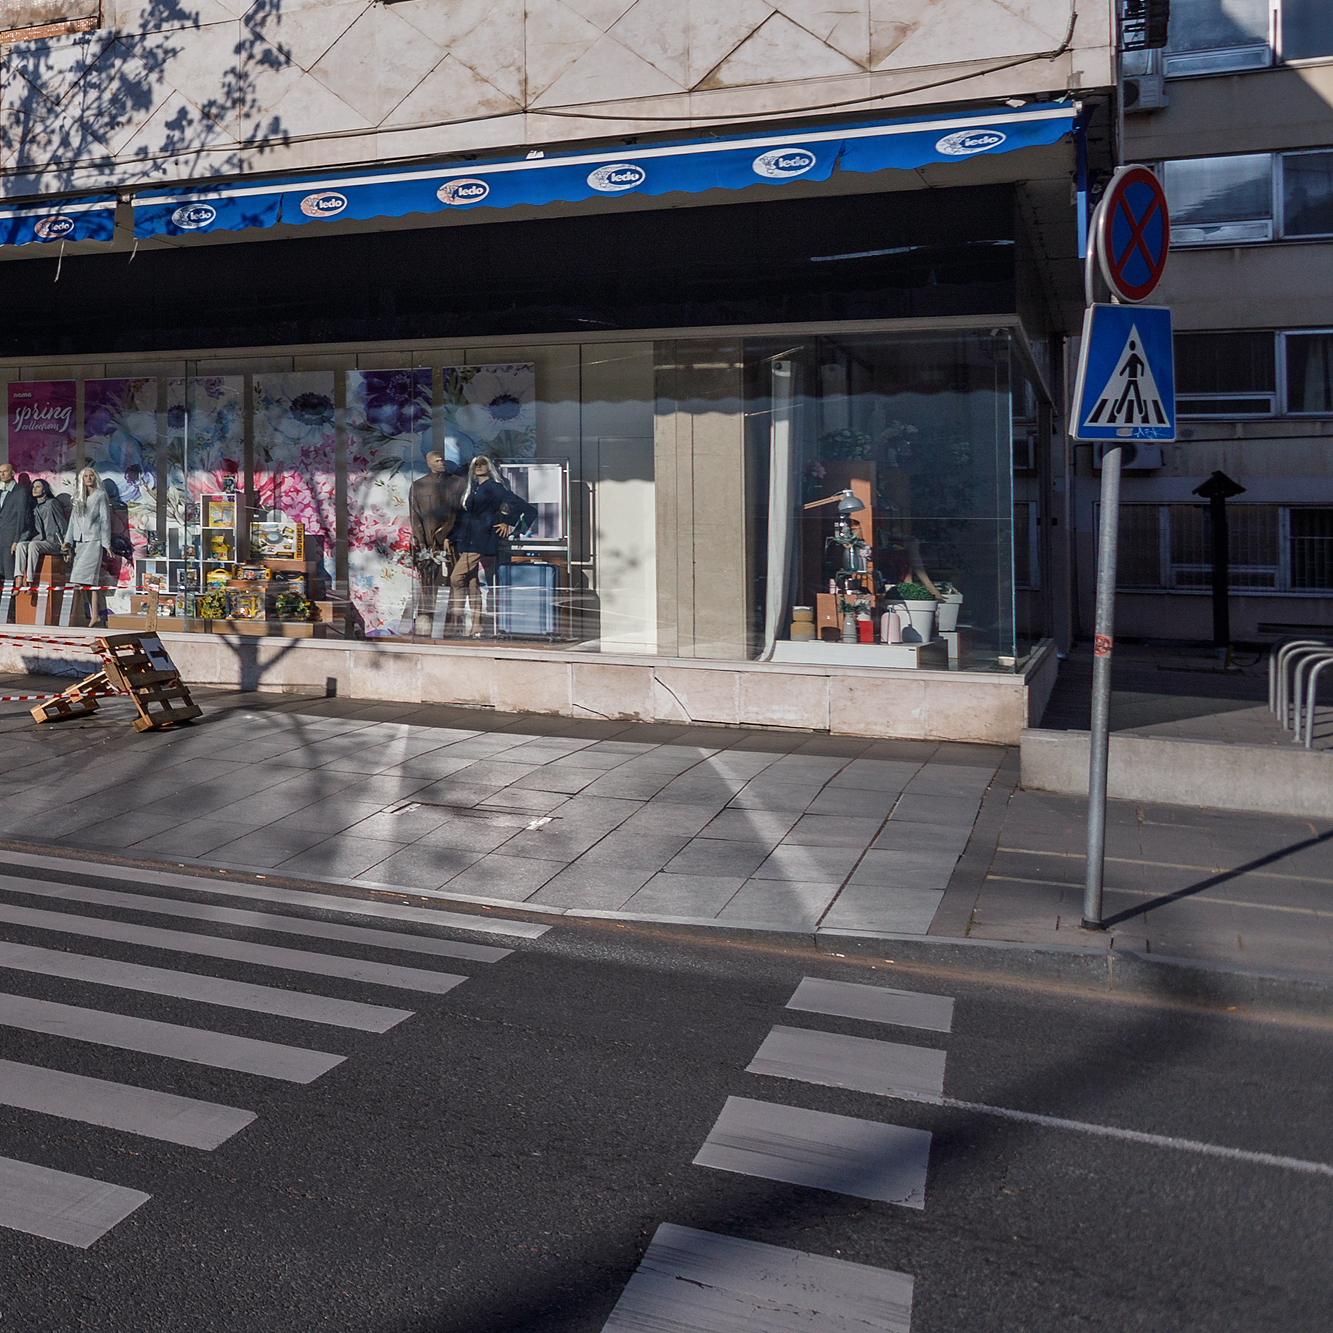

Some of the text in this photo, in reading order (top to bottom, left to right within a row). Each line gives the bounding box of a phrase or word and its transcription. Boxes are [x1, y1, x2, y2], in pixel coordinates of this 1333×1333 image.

[964, 135, 999, 147] ledo
[778, 156, 810, 168] ledo
[610, 171, 639, 182] ledo
[458, 185, 484, 197] ledo
[319, 198, 342, 209] ledo
[190, 210, 212, 220] ledo
[51, 222, 70, 231] ledo
[13, 401, 72, 433] spring
[21, 420, 59, 432] collections
